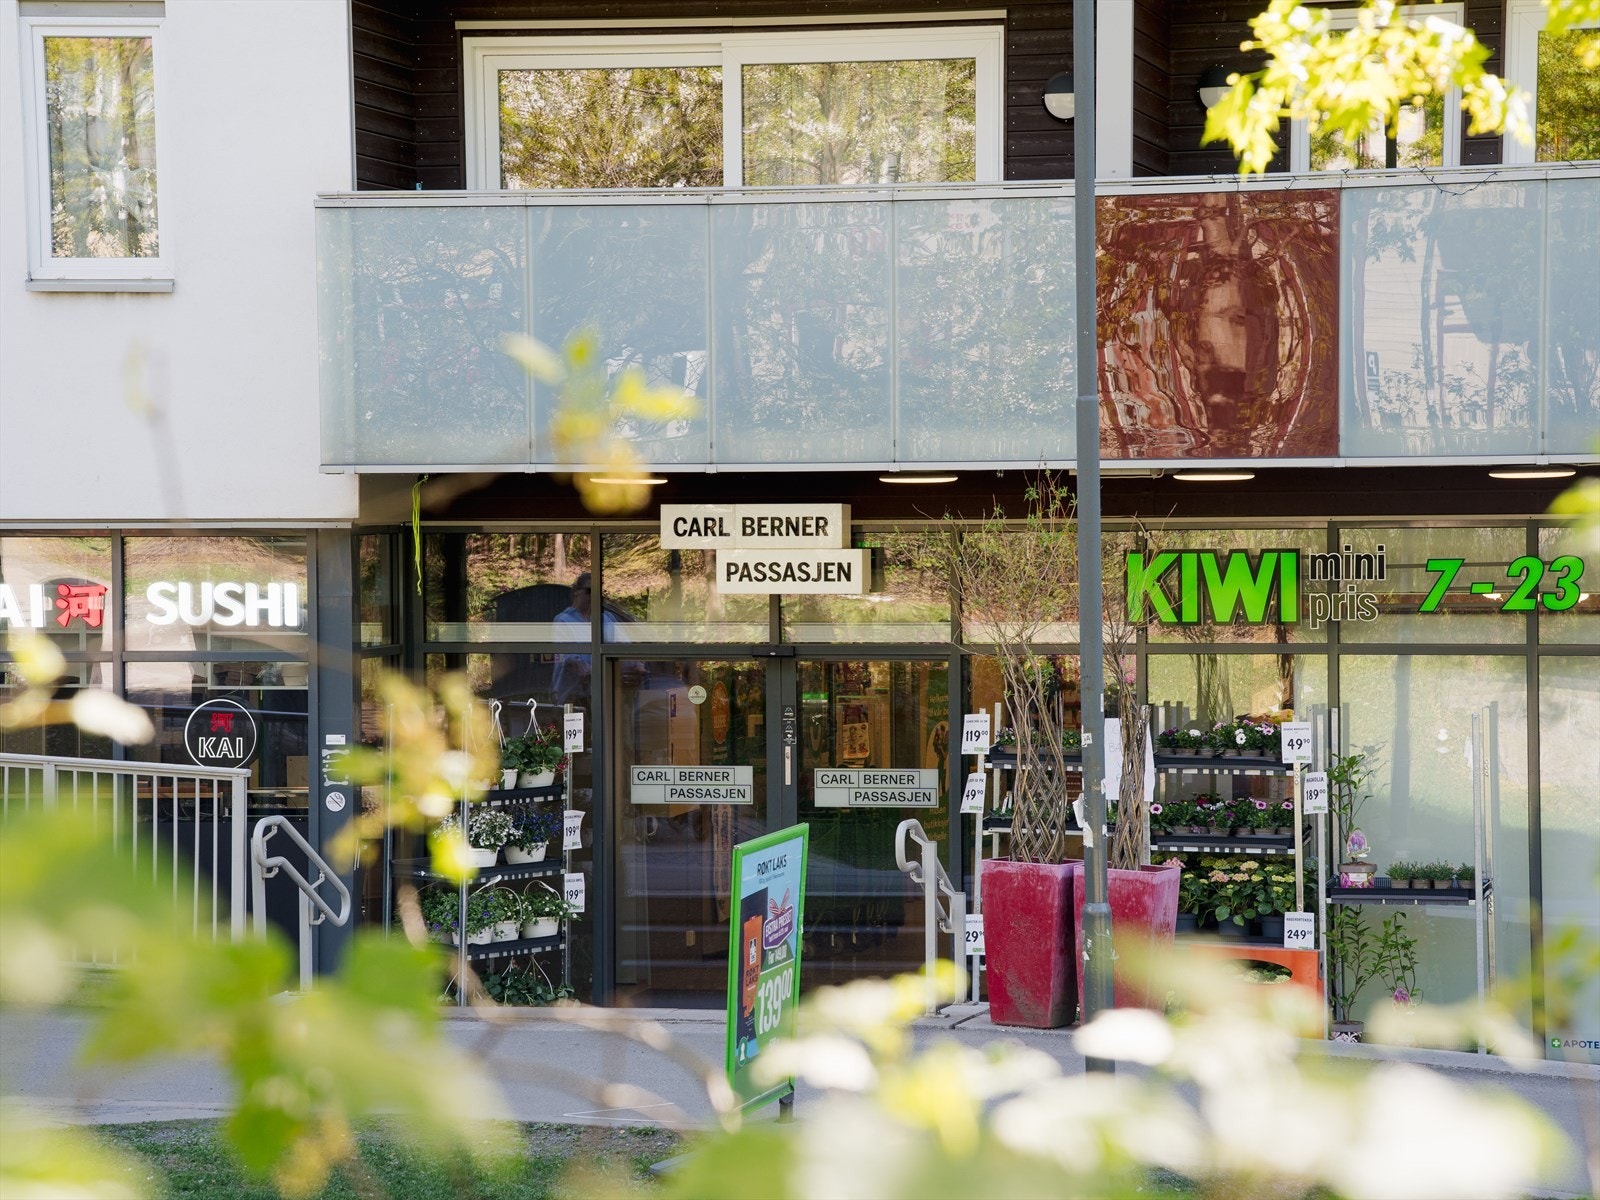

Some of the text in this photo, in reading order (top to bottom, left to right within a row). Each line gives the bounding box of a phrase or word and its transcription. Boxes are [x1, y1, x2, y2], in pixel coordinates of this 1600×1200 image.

[673, 516, 829, 538] CARL BERNER
[726, 561, 851, 583] PASSASJEN
[1309, 544, 1386, 581] mini
[1125, 549, 1300, 625] KIWI
[1418, 558, 1465, 613] 7
[1501, 555, 1585, 612] 23
[55, 583, 108, 628] 河
[146, 581, 299, 627] SUSHI
[1309, 585, 1379, 629] pris
[210, 712, 234, 732] 河
[199, 737, 243, 758] KAI
[637, 771, 730, 783] CARL BERNER
[820, 774, 915, 785] CARL BERNER
[670, 788, 746, 799] PASSASJEN
[854, 791, 932, 803] PASSASJEN
[773, 854, 787, 871] LAKS
[1563, 1040, 1600, 1049] APOTE
